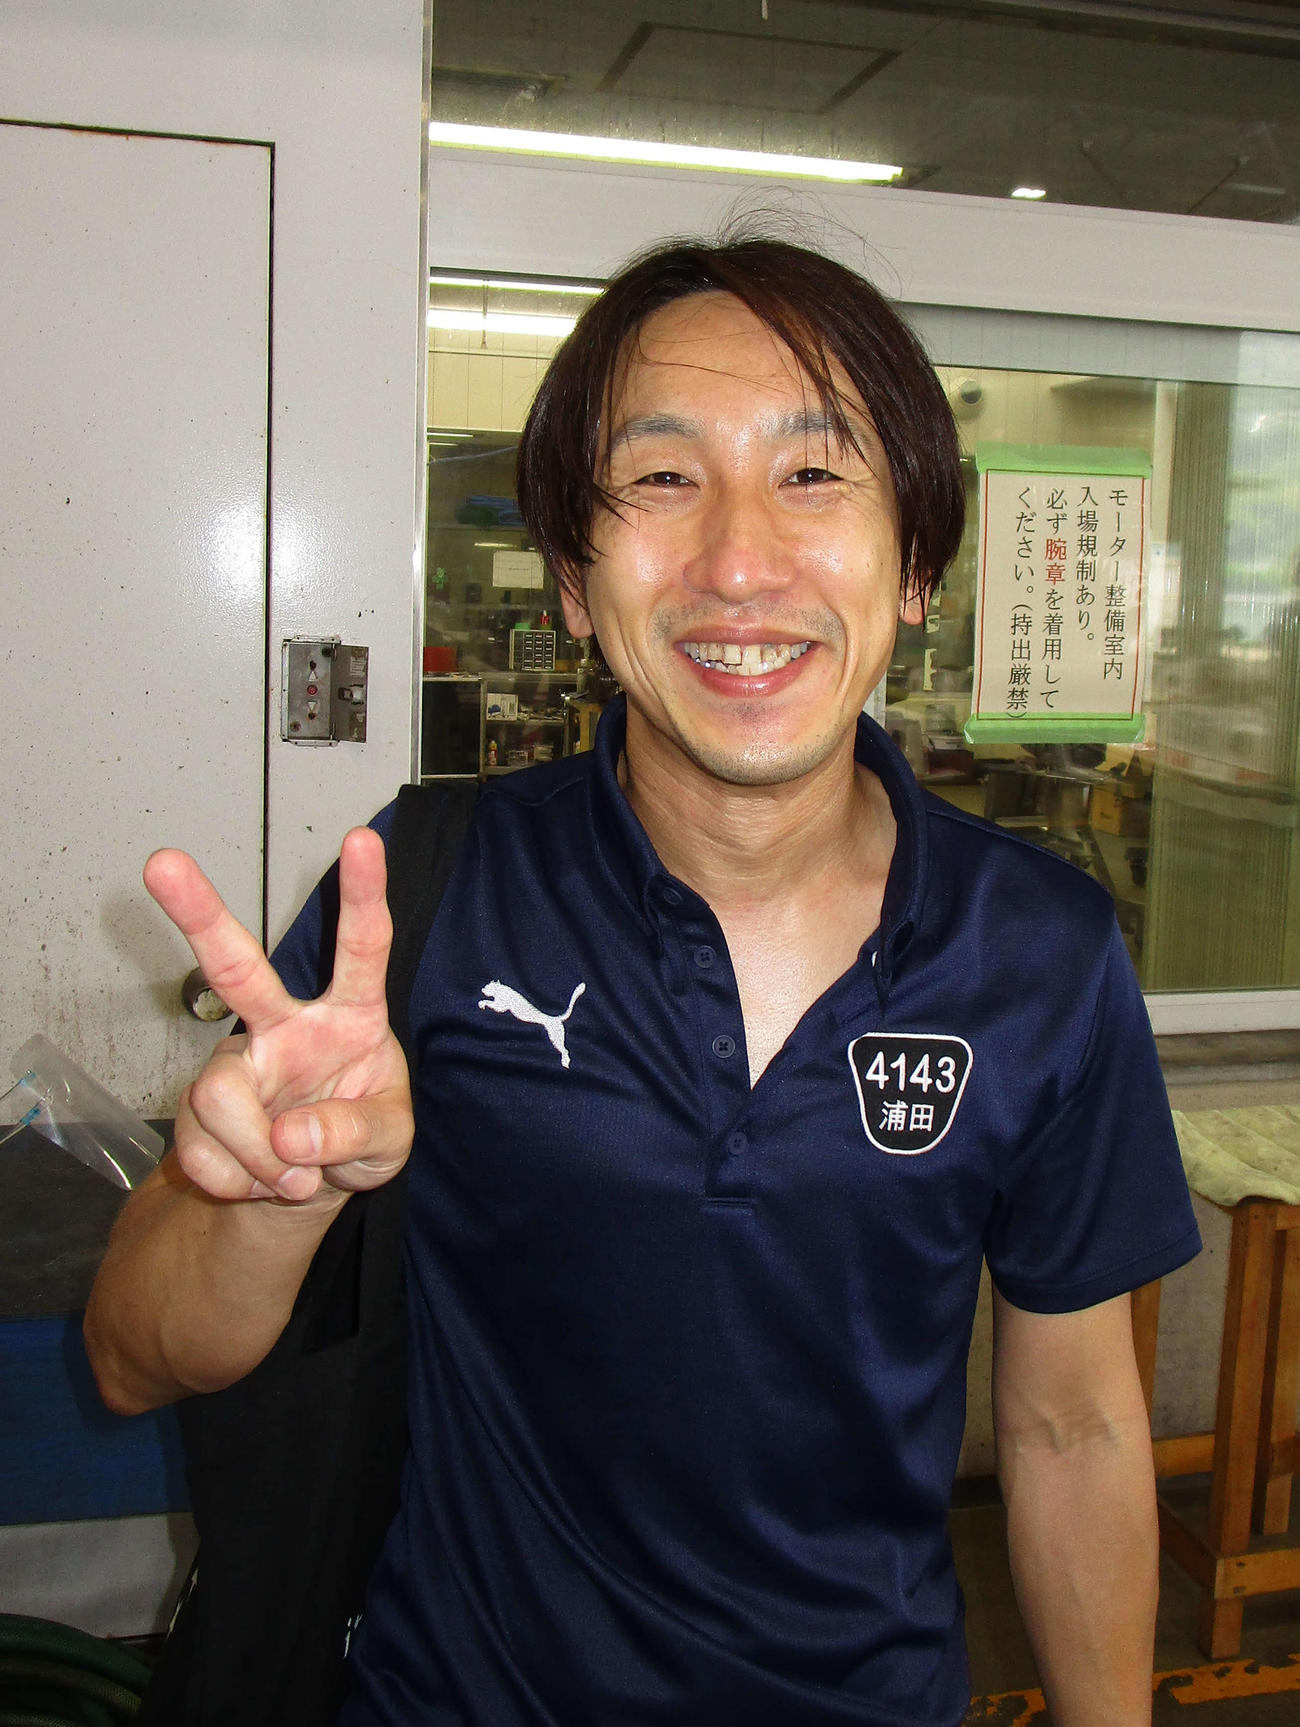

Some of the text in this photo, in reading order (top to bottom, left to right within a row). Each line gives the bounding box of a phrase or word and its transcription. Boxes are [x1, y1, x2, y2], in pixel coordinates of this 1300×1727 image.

[1040, 489, 1067, 708] 必ず腕章を着用して
[1075, 485, 1099, 641] 入場規制あり。
[1103, 488, 1129, 681] モーター整備室内
[865, 1051, 956, 1093] 4143
[879, 1099, 934, 1132] 浦田
